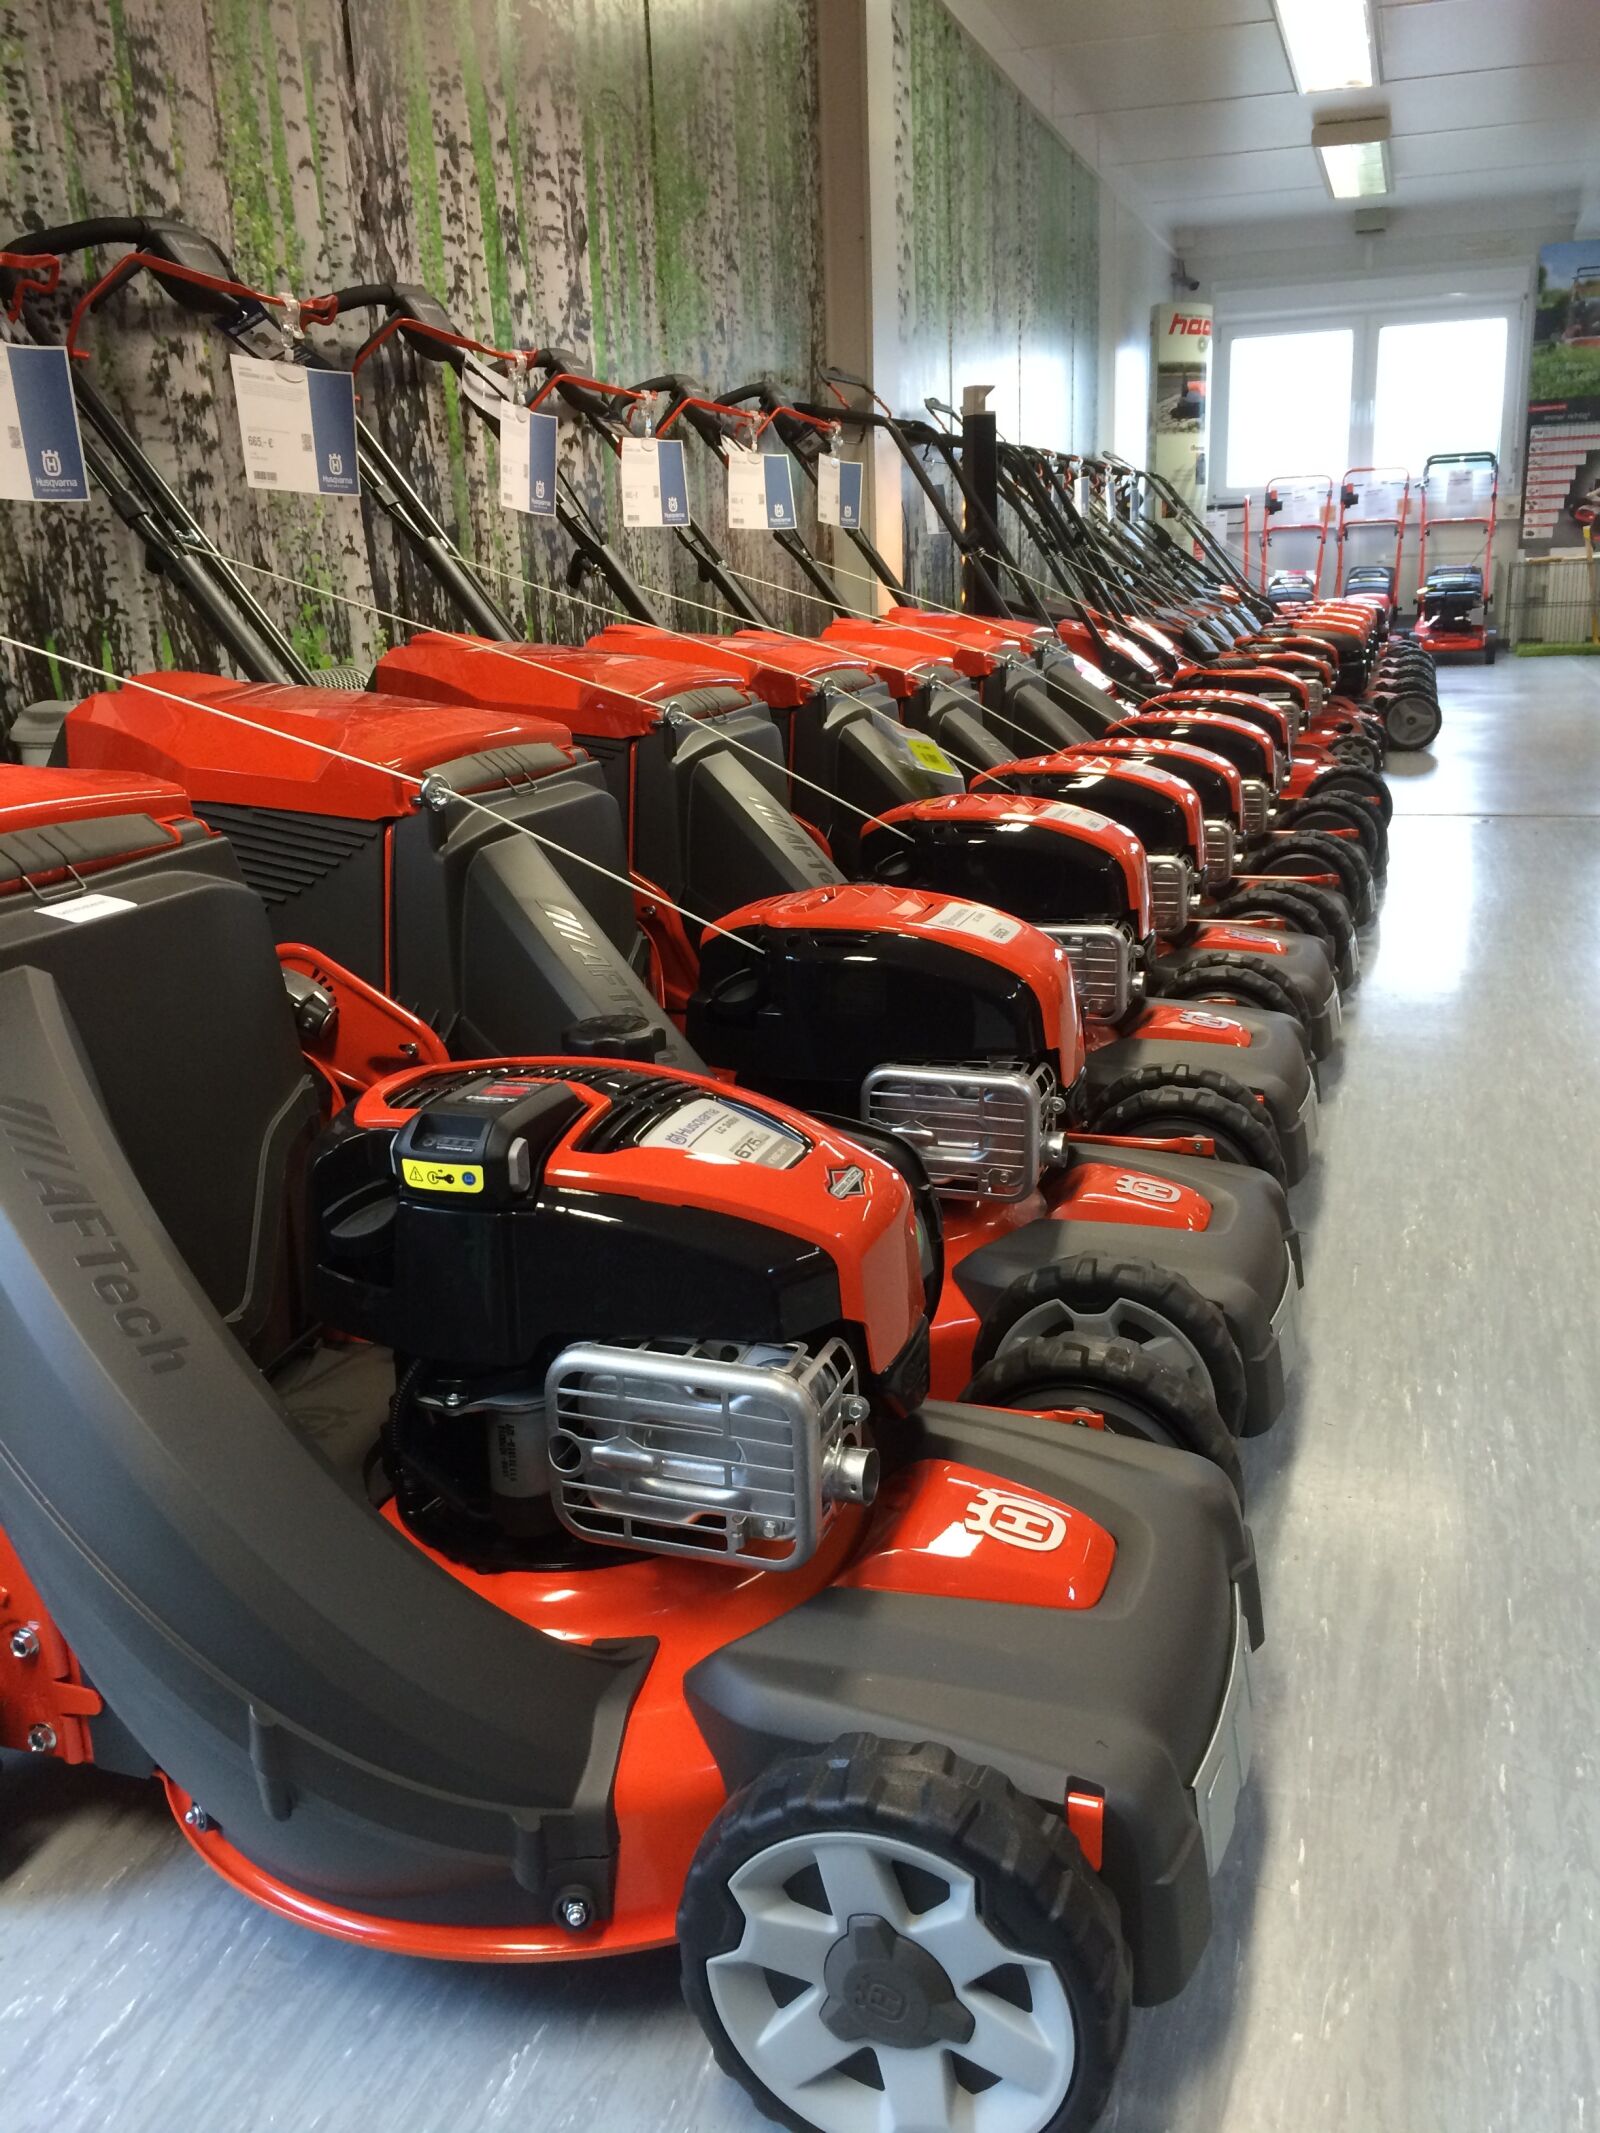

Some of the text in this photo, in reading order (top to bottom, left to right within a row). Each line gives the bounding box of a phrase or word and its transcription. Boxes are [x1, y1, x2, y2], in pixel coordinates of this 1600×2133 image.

[36, 477, 78, 488] Husqvarna
[322, 475, 353, 485] Husqvarna
[678, 1107, 721, 1139] Husqvarna
[21, 1168, 190, 1375] AFTech
